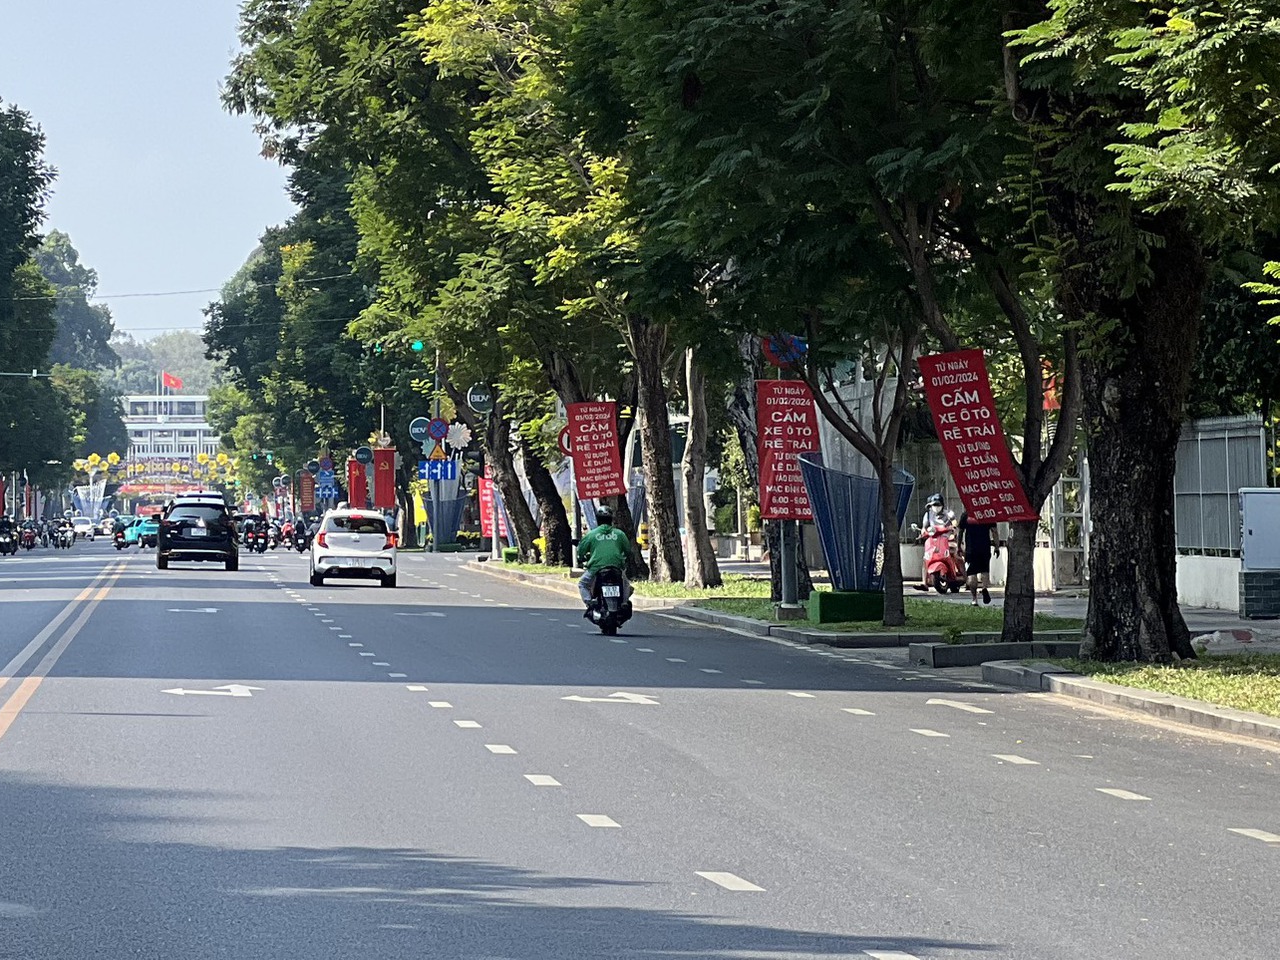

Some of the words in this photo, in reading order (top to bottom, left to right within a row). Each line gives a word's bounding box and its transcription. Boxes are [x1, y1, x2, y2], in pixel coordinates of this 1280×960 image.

[935, 361, 946, 373] TỪ
[947, 360, 969, 371] NGÀY
[932, 372, 979, 386] 01/02/2024
[766, 397, 811, 406] 01/02/2024
[941, 387, 980, 407] CẤM
[771, 408, 806, 423] CẤM
[939, 412, 958, 424] XE
[960, 408, 971, 421] Ô
[971, 406, 990, 420] TÔ
[764, 426, 783, 435] XE
[796, 426, 812, 436] TÔ
[963, 423, 996, 438] TRÁI
[958, 456, 972, 468] LÊ
[596, 531, 618, 541] Grab
